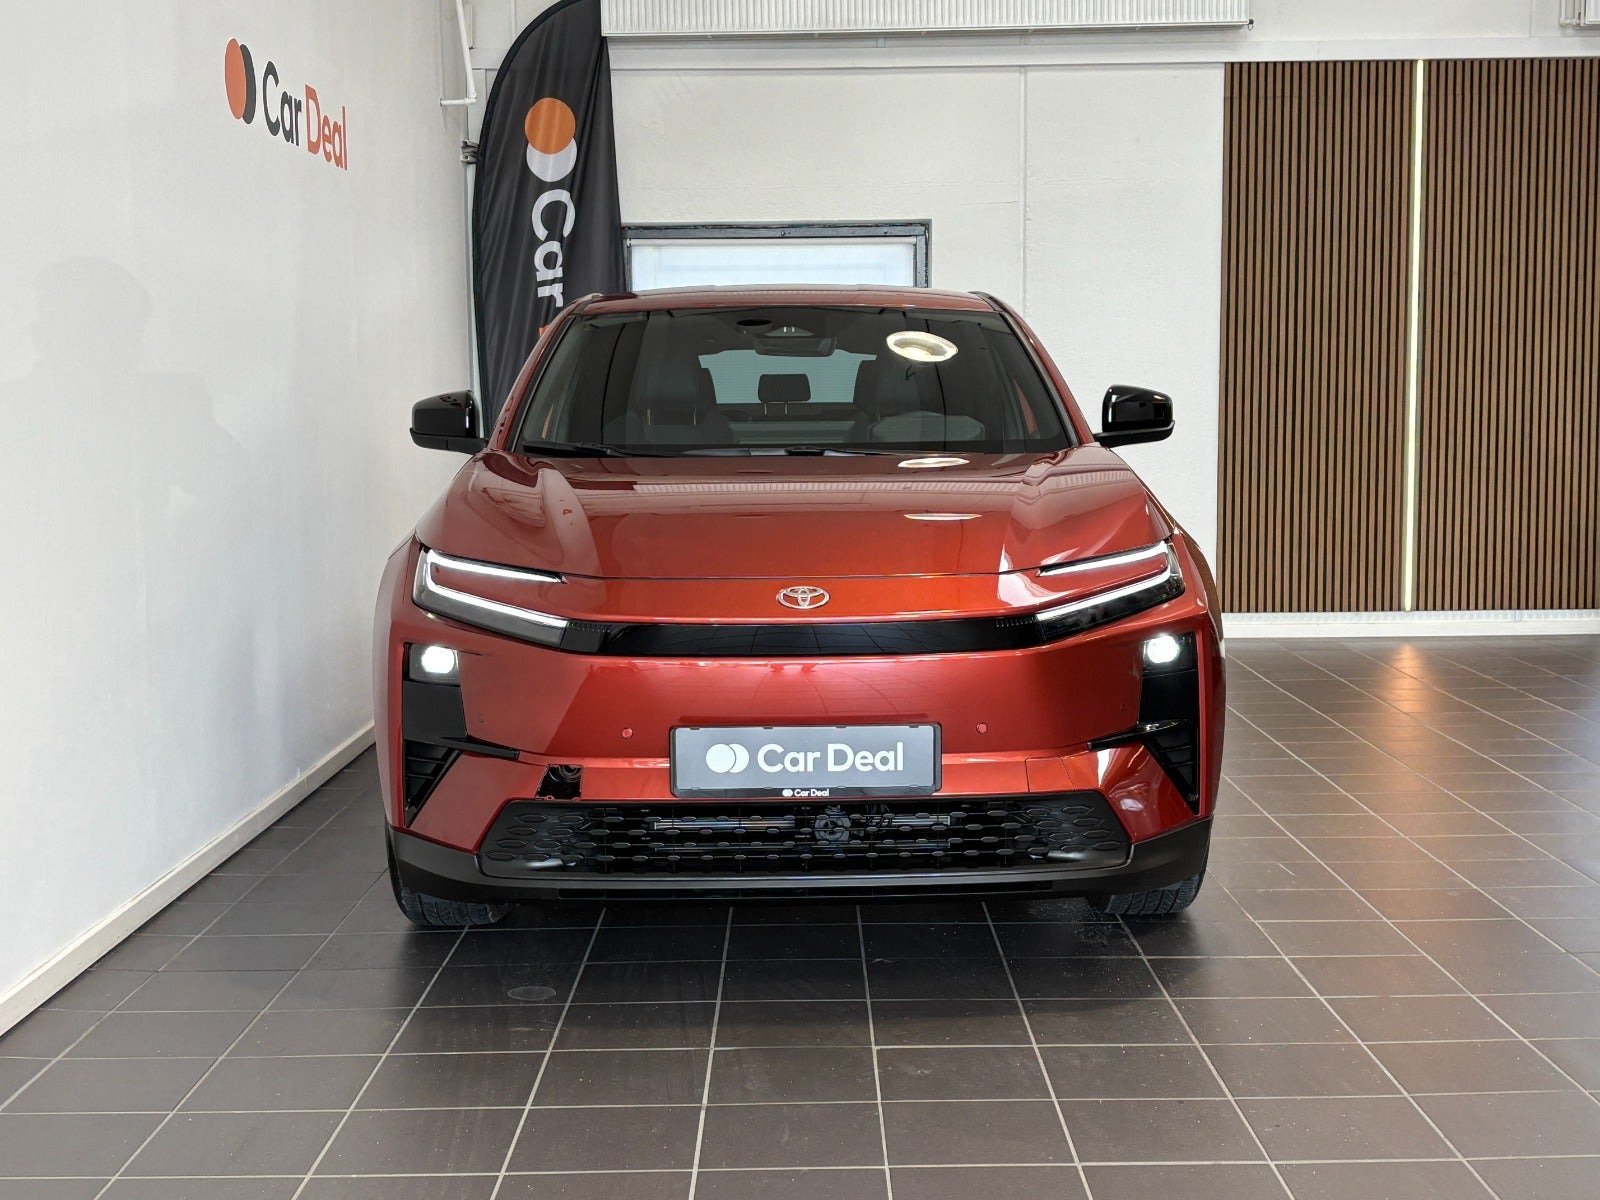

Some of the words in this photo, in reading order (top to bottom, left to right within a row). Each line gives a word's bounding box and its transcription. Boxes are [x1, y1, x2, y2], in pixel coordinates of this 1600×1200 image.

[262, 60, 302, 147] Car
[305, 83, 348, 171] Deal
[531, 188, 576, 308] Car
[757, 743, 821, 773] Car
[827, 741, 904, 773] Deal
[794, 788, 810, 797] Car
[810, 788, 830, 797] Deal
